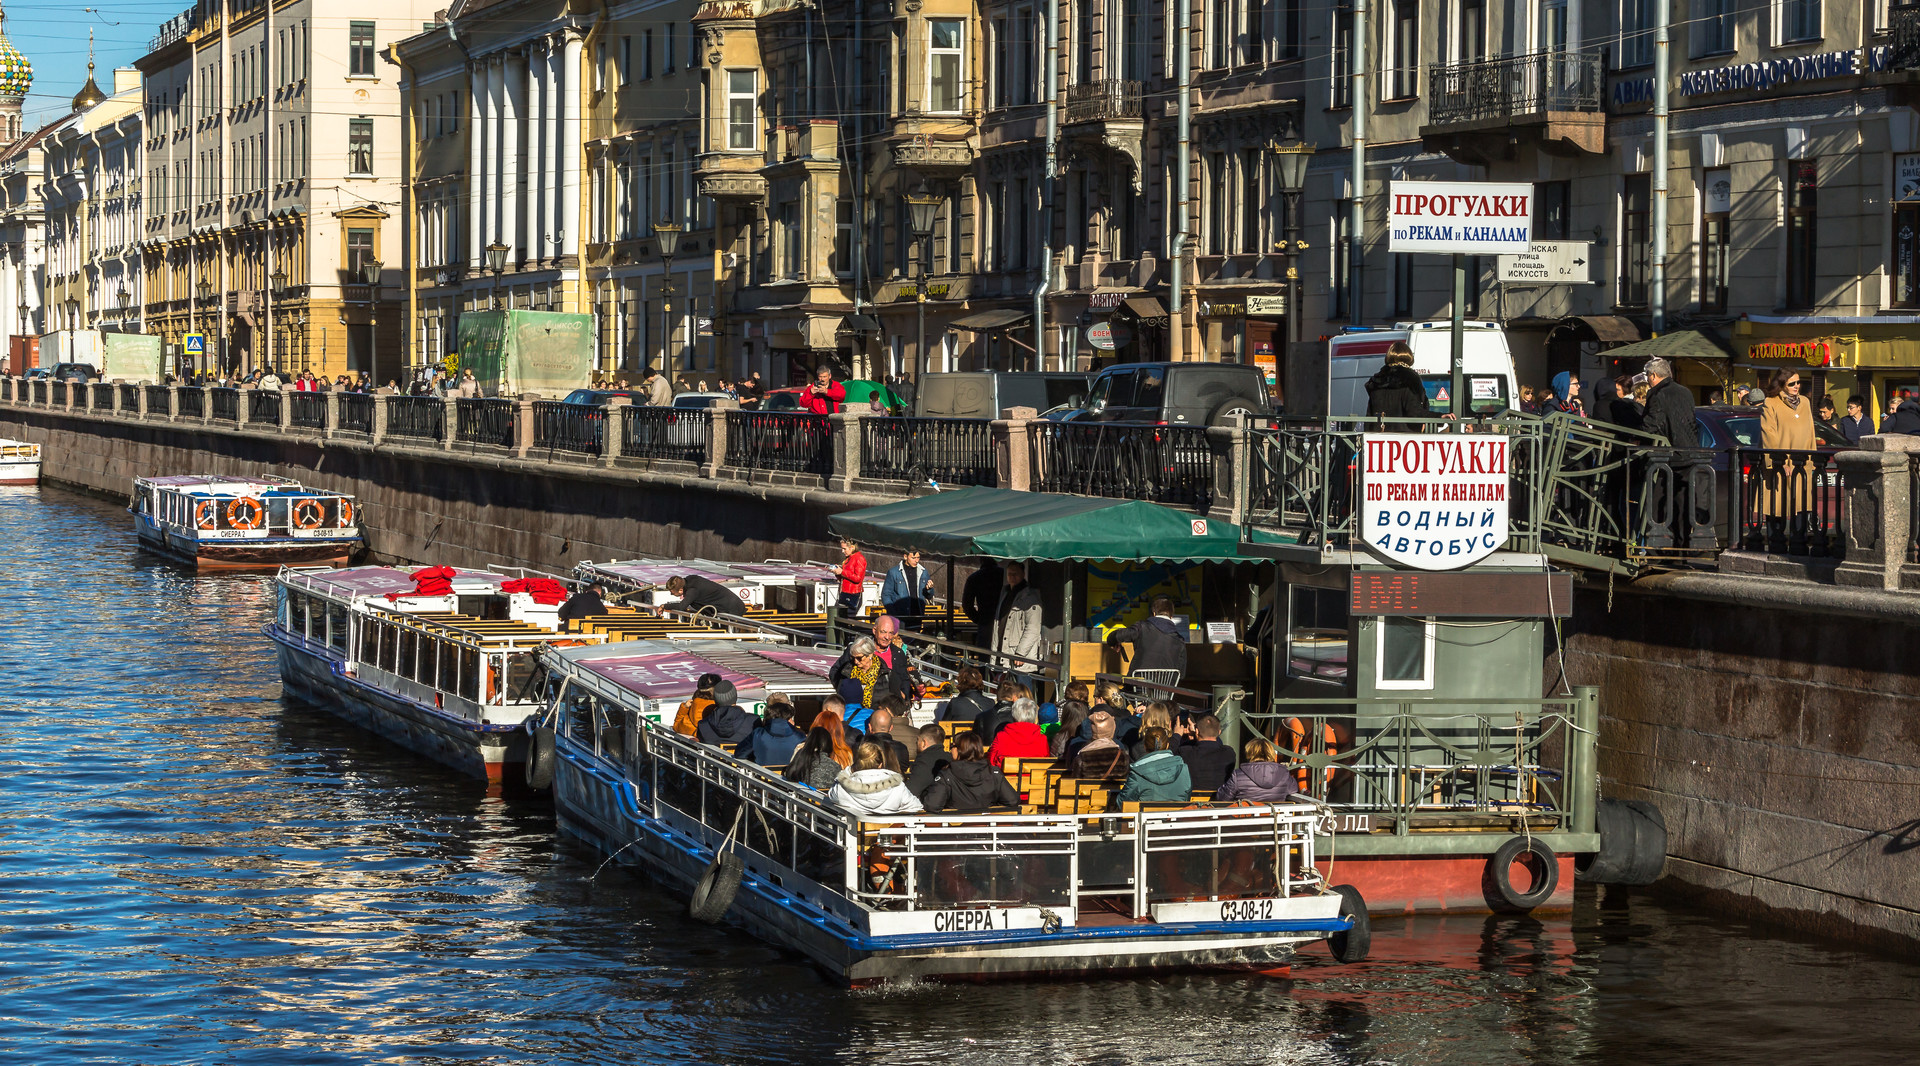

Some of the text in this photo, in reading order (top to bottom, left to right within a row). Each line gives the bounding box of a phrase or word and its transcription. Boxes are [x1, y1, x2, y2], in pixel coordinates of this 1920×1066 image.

[1680, 49, 1862, 97] ЖЕЛЕЗНОДОРОЖНЫЕ
[1394, 194, 1529, 217] ПРОГУЛКИ
[1394, 225, 1528, 242] по РЕКАМ и КАНАЛАМ
[1531, 245, 1558, 253] НСКАЯ
[1508, 270, 1549, 278] ИСКУССТВ
[1748, 343, 1801, 359] СТОЛОВАЯ
[1366, 440, 1507, 475] ПРОГУЛКИ
[1367, 483, 1505, 502] ПО РЕКАМ И КАНАЛАМ
[1377, 508, 1496, 531] ВОДНЫЙ
[220, 530, 246, 538] СИЕРРА 2
[1376, 532, 1496, 556] АВТОБУС
[1343, 814, 1370, 832] ЛД
[934, 909, 1009, 932] СИЕРРА 1
